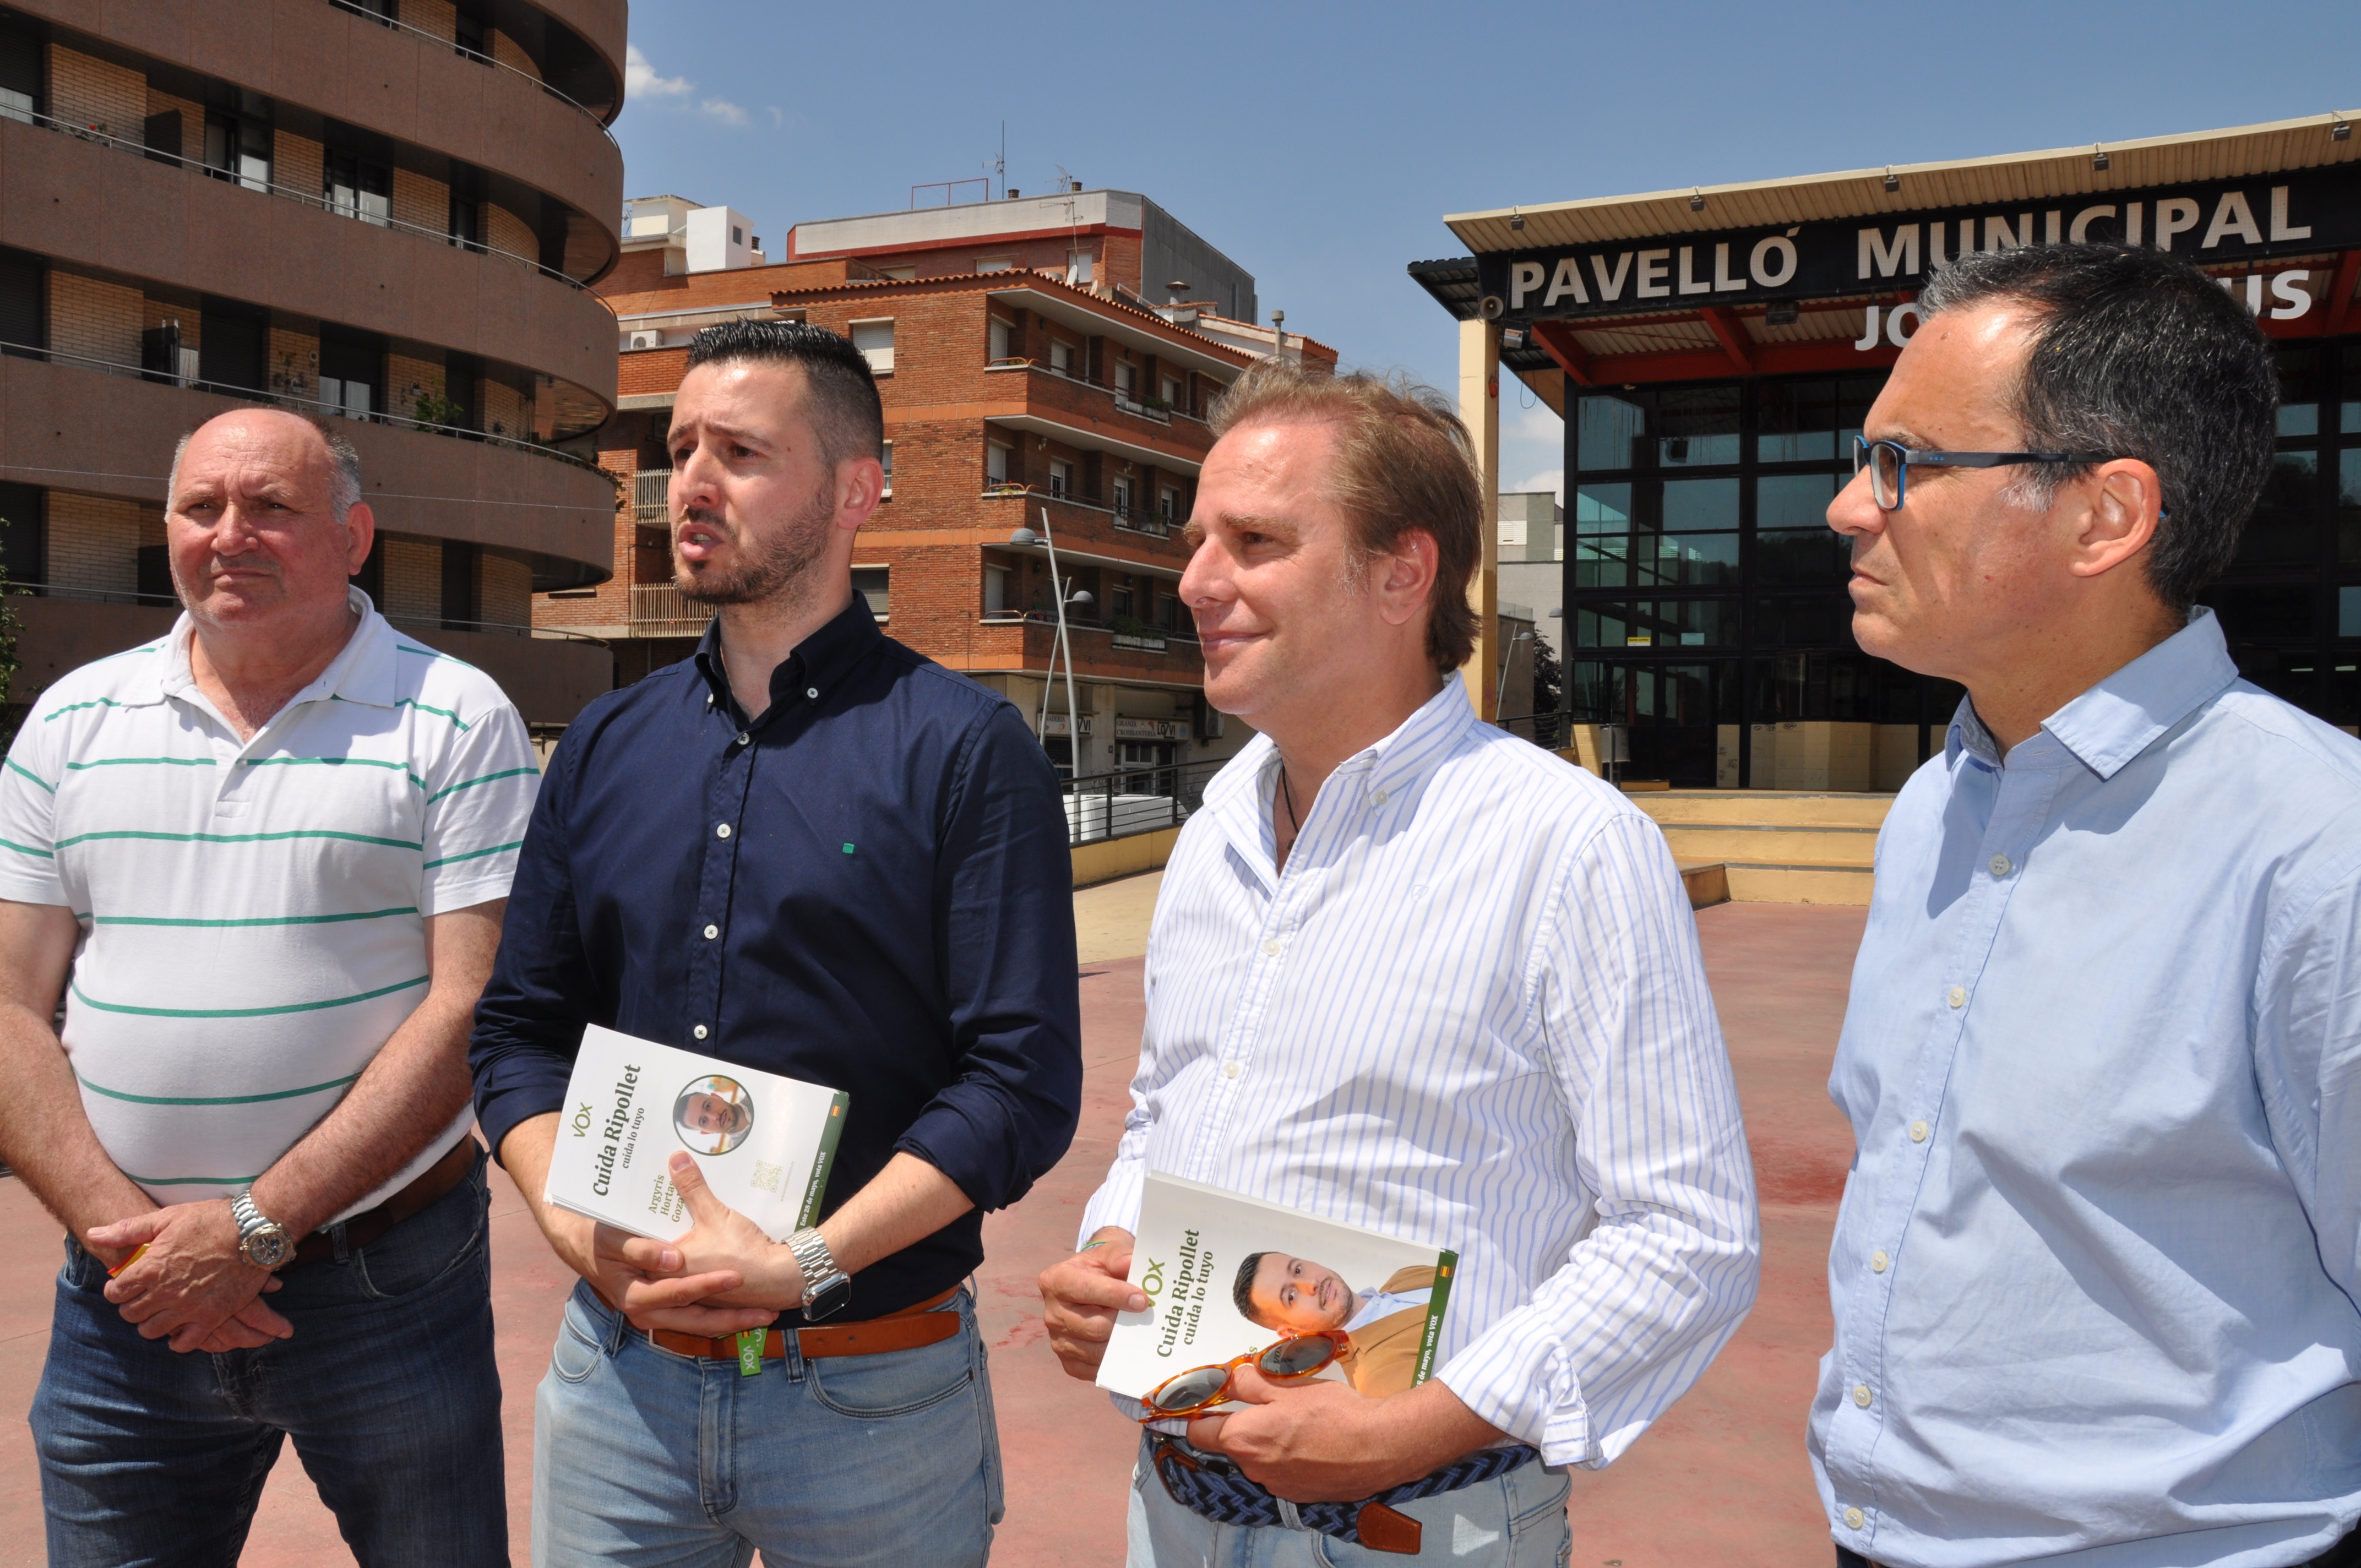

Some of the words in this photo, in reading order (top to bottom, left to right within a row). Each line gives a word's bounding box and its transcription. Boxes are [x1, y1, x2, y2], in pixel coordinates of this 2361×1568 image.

[1511, 226, 1802, 310] PAVELLÓ
[603, 1064, 641, 1142] Ripollet
[572, 1102, 593, 1137] VOX
[631, 1107, 645, 1130] tuyo
[627, 1131, 638, 1141] lo
[622, 1140, 635, 1169] cuida
[818, 1151, 826, 1164] VOX
[593, 1145, 617, 1196] Cuida
[648, 1175, 665, 1213] Argyris
[809, 1179, 820, 1197] mayo,
[672, 1193, 684, 1222] Goza
[803, 1205, 810, 1213] 28
[806, 1196, 813, 1205] de
[799, 1213, 808, 1226] Este
[1196, 1251, 1214, 1284] tuyo
[1157, 1305, 1184, 1357] Cuida
[1172, 1229, 1199, 1302] Ripollet
[1191, 1287, 1206, 1302] lo
[1184, 1304, 1202, 1345] cuida
[1429, 1314, 1438, 1330] VOX
[1427, 1331, 1435, 1347] vota
[743, 1345, 755, 1370] VOX
[1421, 1349, 1433, 1370] mayo,
[1418, 1370, 1426, 1380] de
